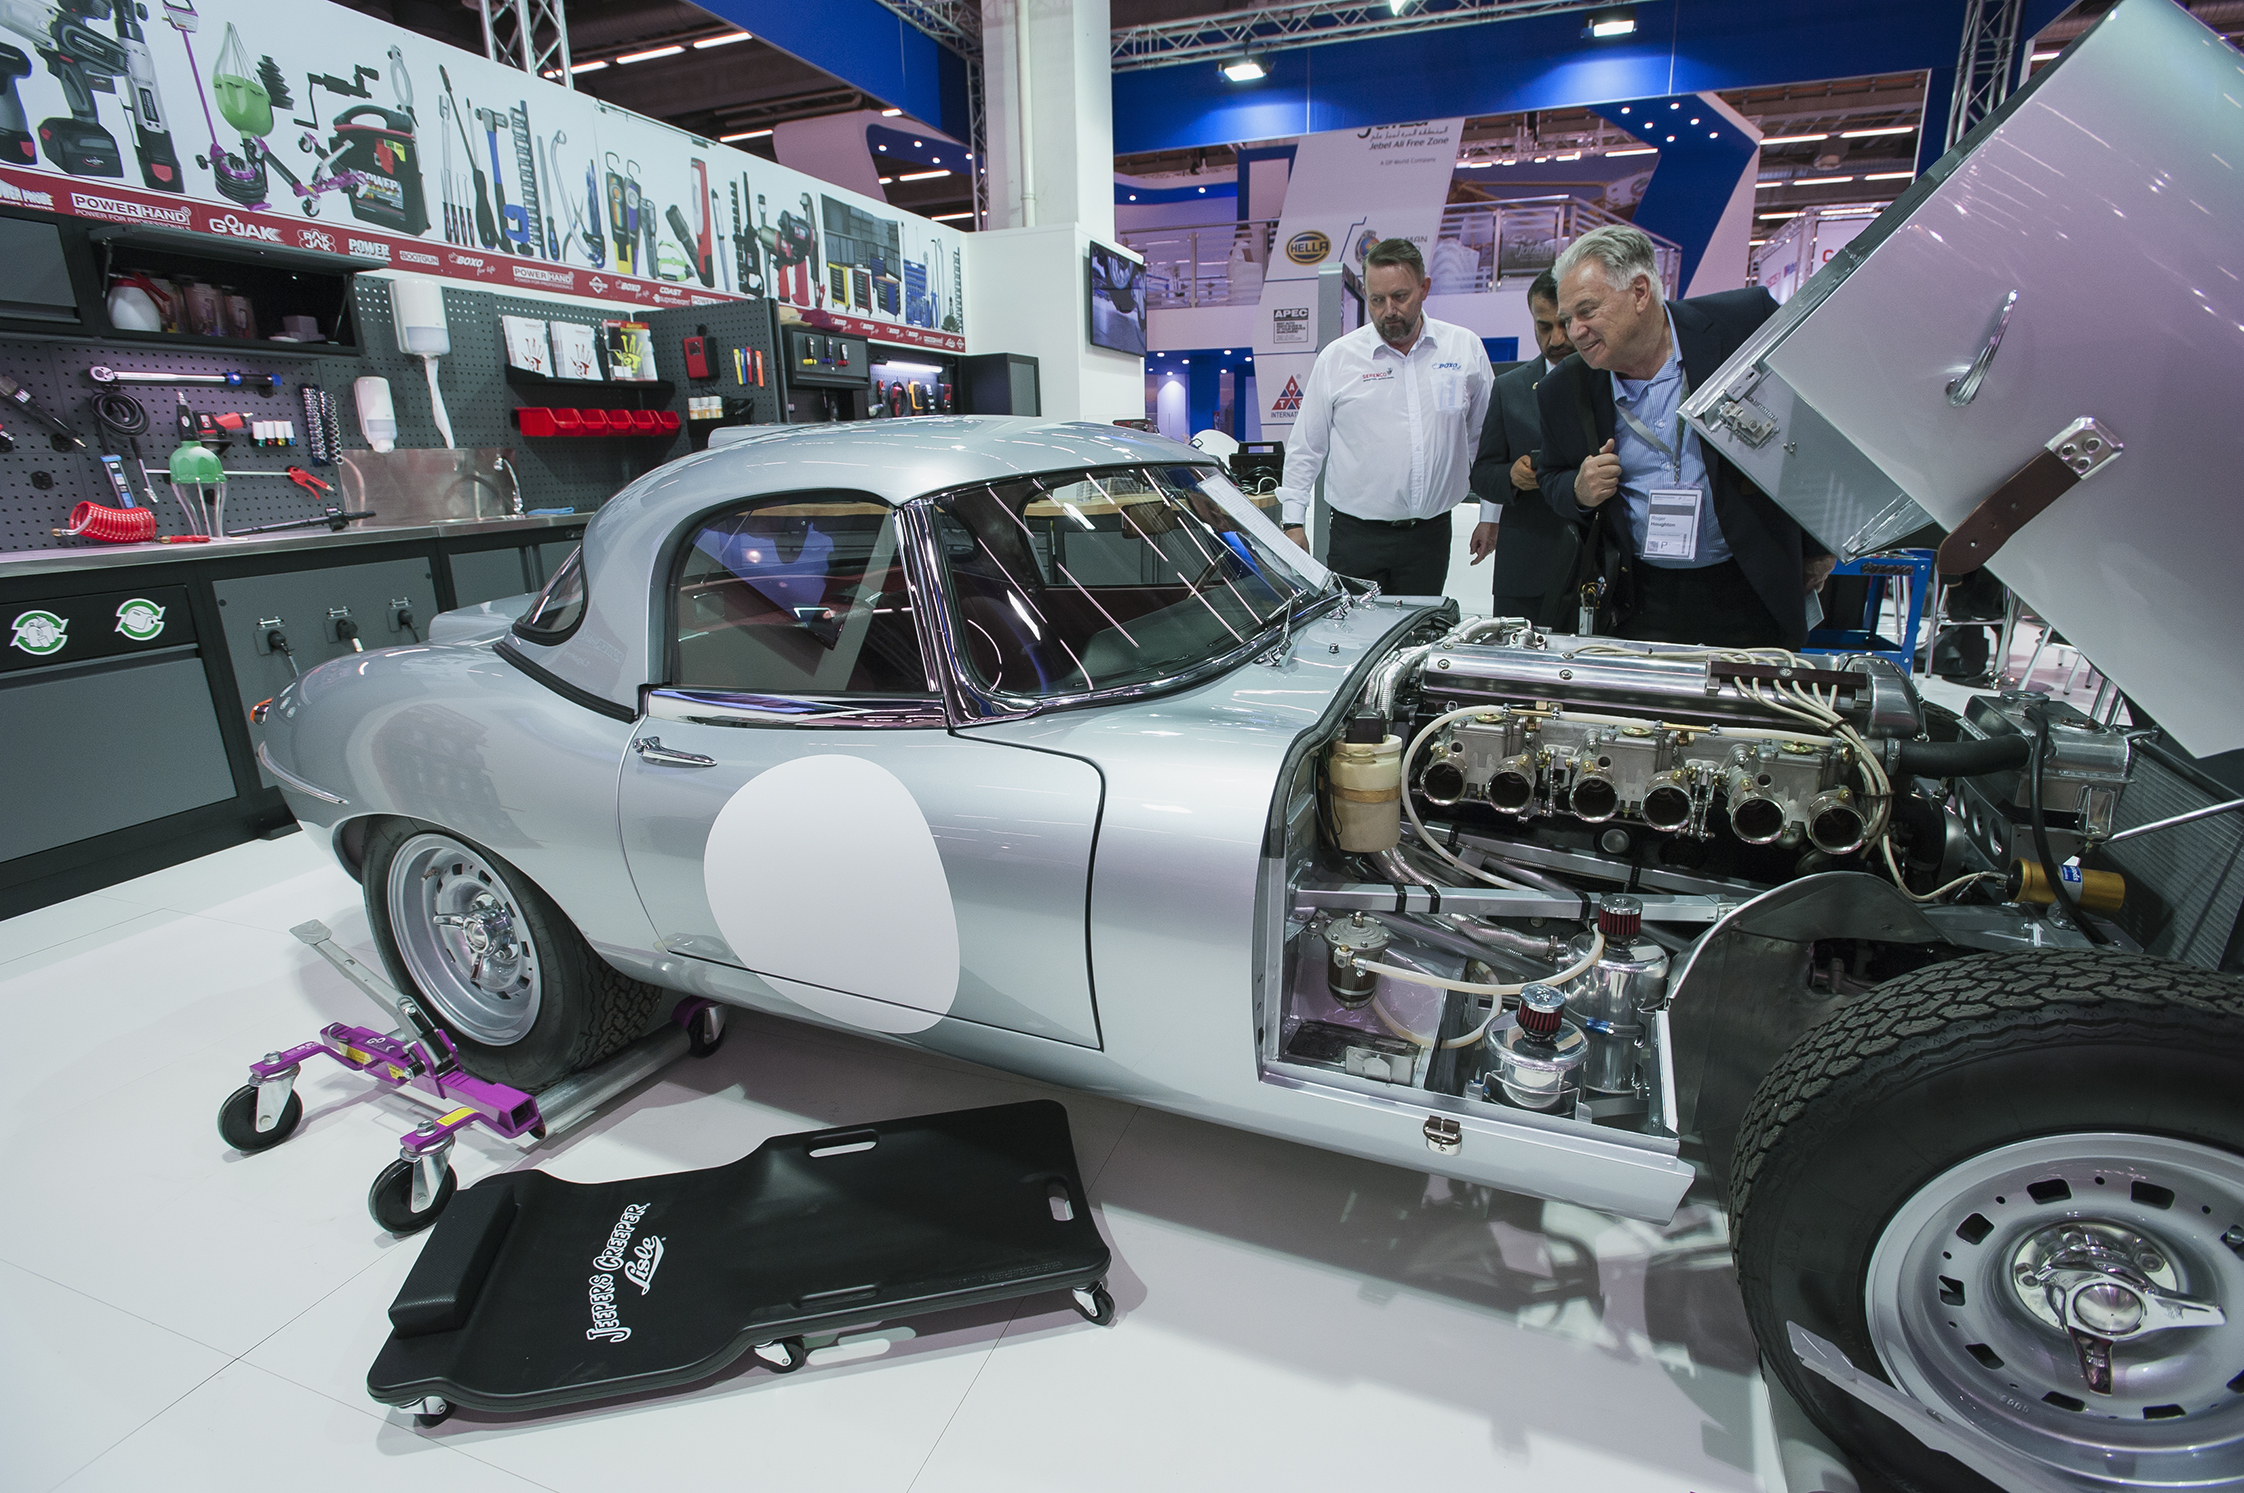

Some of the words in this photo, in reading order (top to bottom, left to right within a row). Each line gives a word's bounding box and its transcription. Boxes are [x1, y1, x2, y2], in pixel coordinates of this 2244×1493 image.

[1369, 141, 1391, 150] Jebel
[1393, 139, 1405, 148] Ali
[1406, 138, 1425, 147] Free
[1427, 137, 1449, 146] Zone
[75, 195, 138, 215] POWER
[141, 206, 188, 223] HAND
[75, 209, 107, 220] POWER
[108, 213, 126, 222] FOR
[303, 229, 329, 243] RAK
[305, 240, 331, 252] JAK
[349, 238, 390, 256] POWER
[1290, 240, 1329, 253] HELLA
[457, 255, 484, 268] BOXO
[515, 268, 546, 279] POWER
[659, 287, 683, 296] COAST
[1275, 308, 1308, 318] APEC
[592, 1202, 650, 1272] CREEPER
[624, 1235, 665, 1296] Lisle
[586, 1273, 632, 1343] JEEPERS
